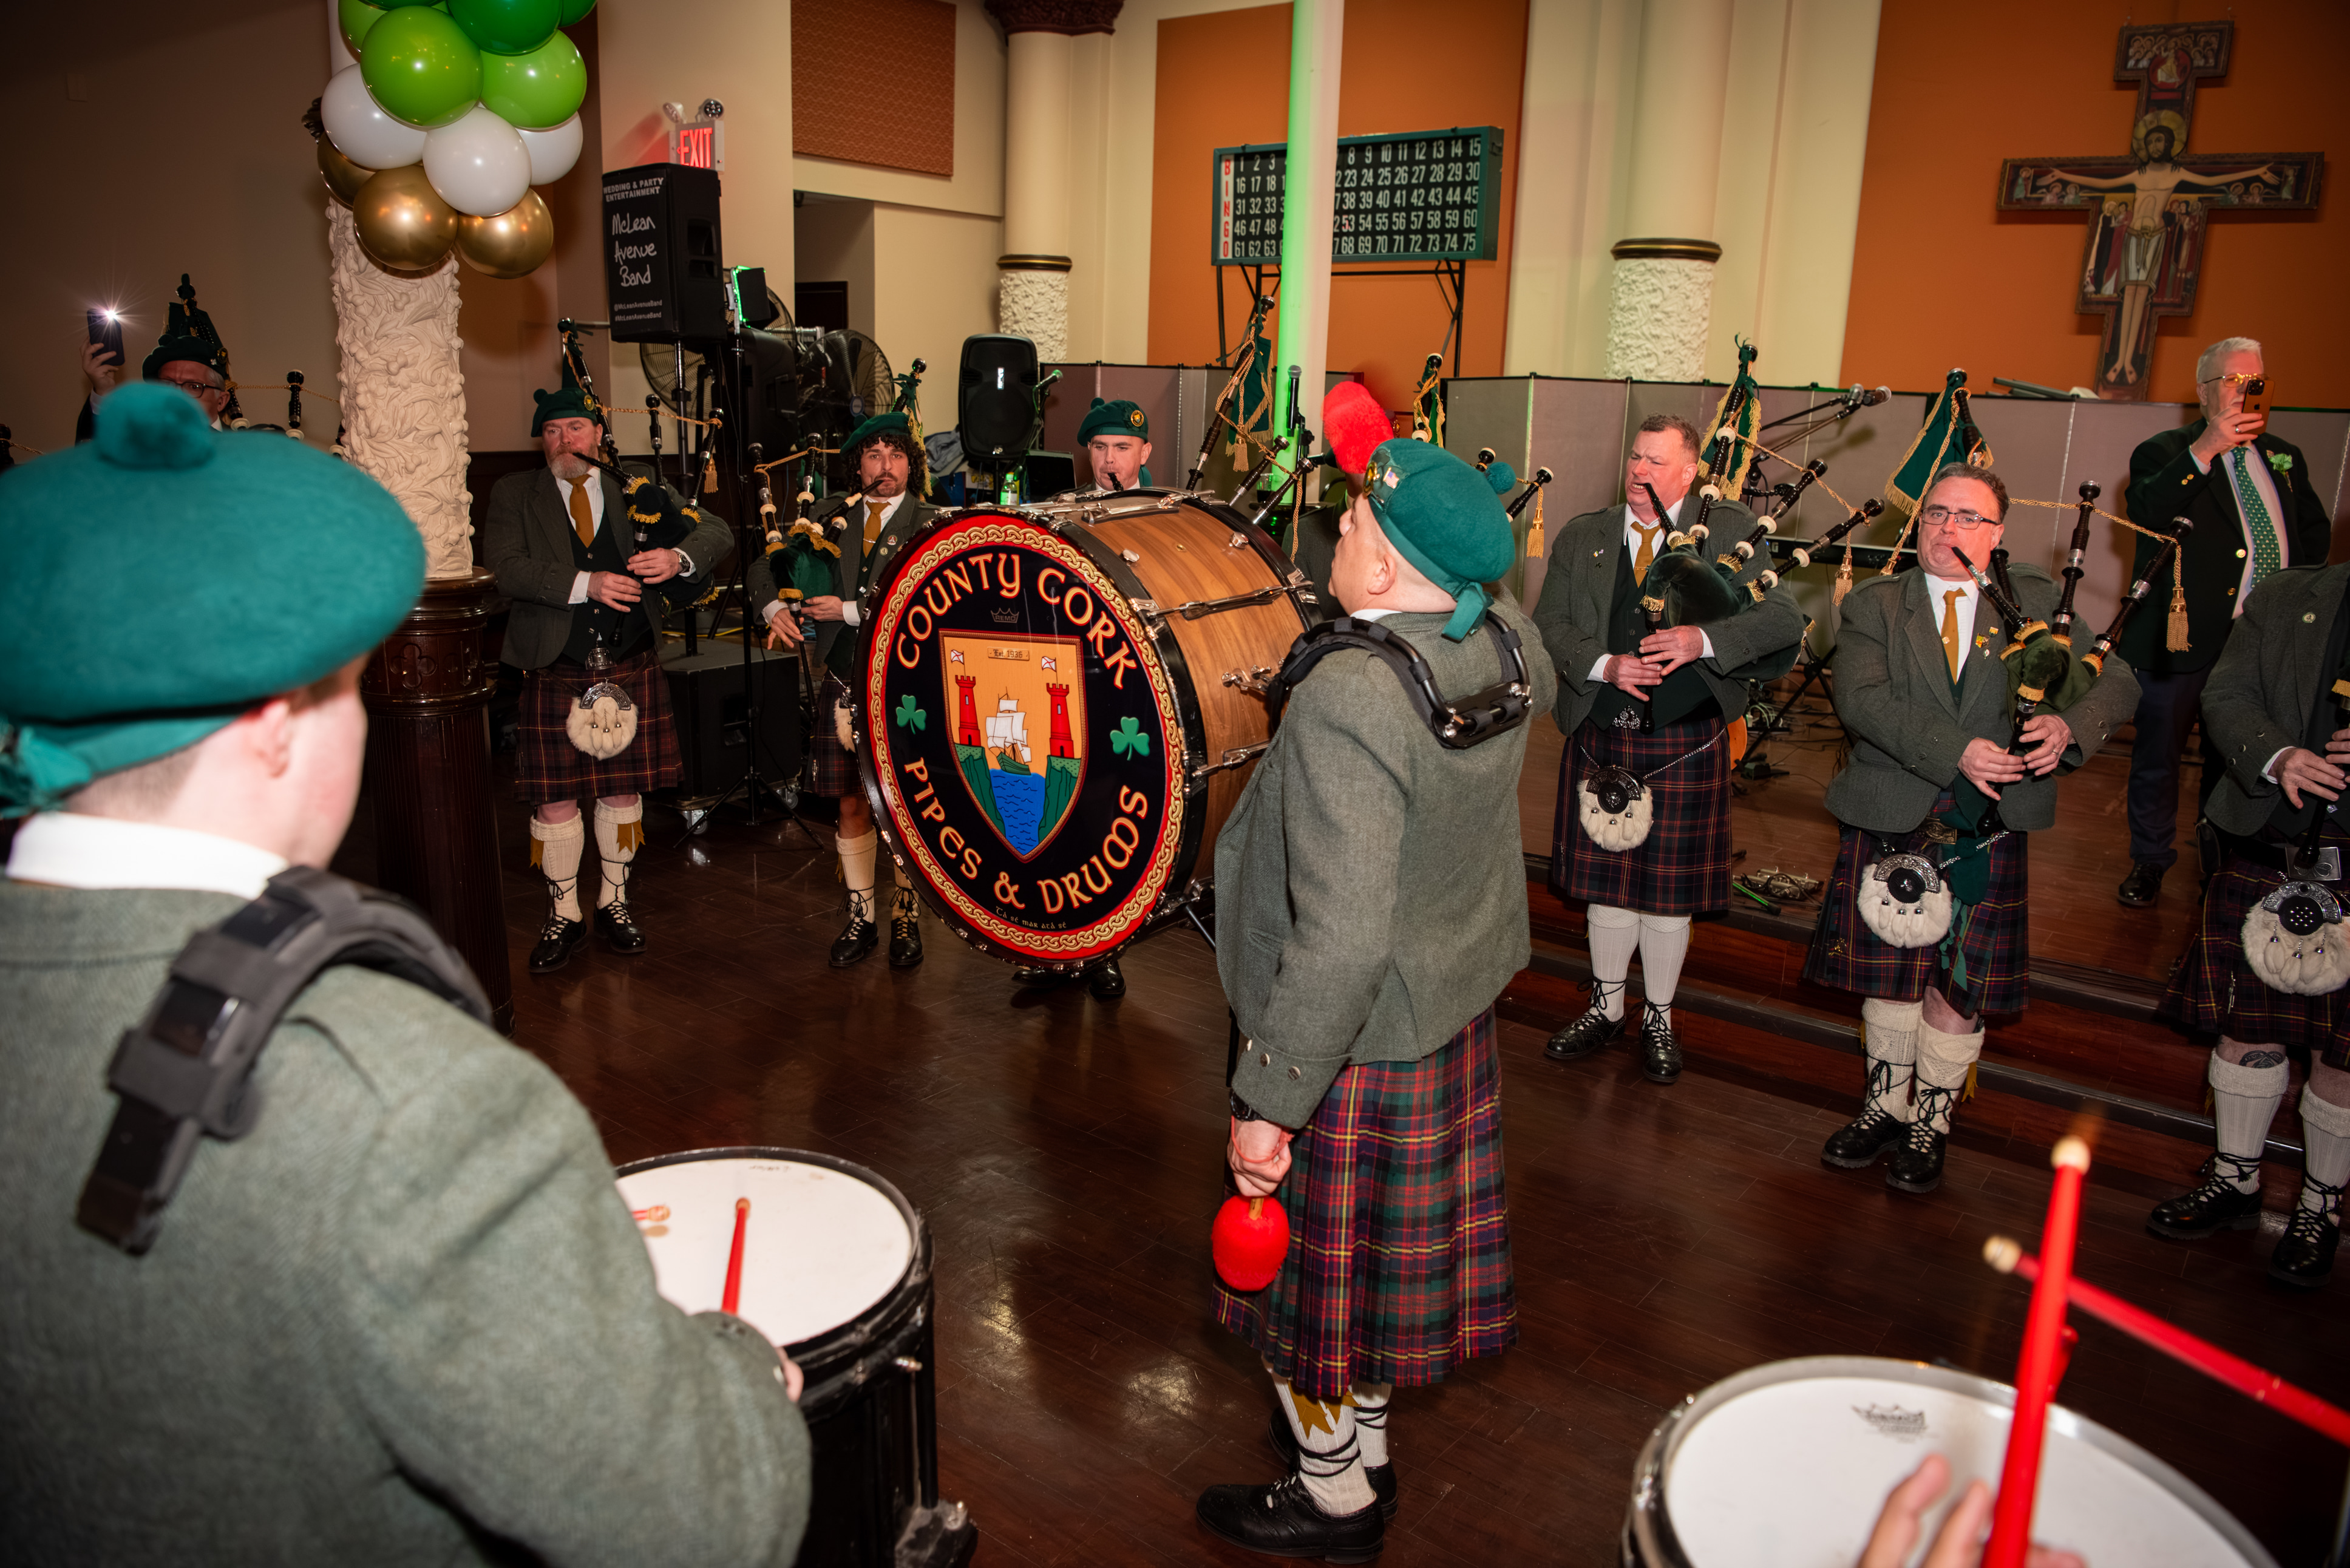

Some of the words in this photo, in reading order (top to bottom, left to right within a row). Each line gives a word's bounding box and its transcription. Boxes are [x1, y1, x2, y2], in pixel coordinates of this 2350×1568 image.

[680, 127, 713, 168] EXIT
[1240, 156, 1244, 172] 1
[1254, 155, 1260, 171] 2
[1269, 154, 1275, 170] 3
[1348, 147, 1355, 165] 8
[1365, 145, 1372, 164] 9
[1381, 144, 1391, 163] 10
[1398, 143, 1407, 161] 11
[1415, 141, 1426, 160] 12
[1433, 140, 1444, 159] 13
[1451, 139, 1462, 158] 14
[1470, 138, 1481, 156] 15
[603, 182, 631, 194] WEDDING
[639, 177, 664, 188] PARTY
[1236, 177, 1246, 194] 16
[1251, 175, 1261, 193] 17
[1266, 175, 1276, 192] 18
[1344, 169, 1357, 187] 23
[1361, 168, 1373, 186] 24
[1377, 167, 1391, 186] 25
[1394, 166, 1408, 185] 26
[1411, 165, 1425, 183] 27
[1430, 163, 1444, 182] 28
[1447, 162, 1462, 182] 29
[1465, 161, 1480, 181] 30
[606, 186, 661, 202] ENTERTAINMENT
[1236, 199, 1245, 215] 31
[1249, 197, 1261, 214] 32
[1265, 197, 1276, 214] 33
[1343, 191, 1356, 209] 38
[1359, 191, 1373, 209] 39
[1376, 189, 1390, 208] 40
[1394, 189, 1406, 208] 41
[1411, 188, 1425, 206] 42
[1428, 187, 1442, 206] 43
[1446, 186, 1461, 205] 44
[1464, 186, 1479, 204] 45
[612, 212, 656, 236] McLean
[1234, 220, 1246, 236] 46
[1249, 219, 1261, 236] 47
[1264, 219, 1276, 235] 48
[1342, 214, 1355, 232] 53
[1359, 214, 1372, 231] 54
[1376, 212, 1388, 231] 55
[1392, 212, 1406, 230] 56
[1410, 211, 1424, 229] 57
[1427, 211, 1441, 229] 58
[1445, 209, 1459, 228] 59
[1464, 209, 1478, 228] 60
[614, 240, 657, 265] Avenue
[1234, 241, 1245, 257] 61
[1249, 240, 1261, 257] 62
[1264, 240, 1276, 257] 63
[1342, 236, 1354, 254] 68
[1358, 236, 1371, 254] 69
[1376, 236, 1387, 253] 70
[1393, 235, 1404, 253] 71
[1409, 234, 1422, 253] 72
[1427, 234, 1439, 252] 73
[1444, 233, 1458, 252] 74
[1463, 233, 1476, 251] 75
[619, 264, 651, 287] Band
[614, 299, 662, 311] @McLeanAvenueBand
[897, 553, 1020, 669] COUNTY
[1037, 568, 1137, 690] CORK
[993, 649, 1005, 657] Est.
[904, 757, 983, 880] PIPES
[994, 871, 1026, 910] &
[1037, 784, 1149, 914] DRUMS
